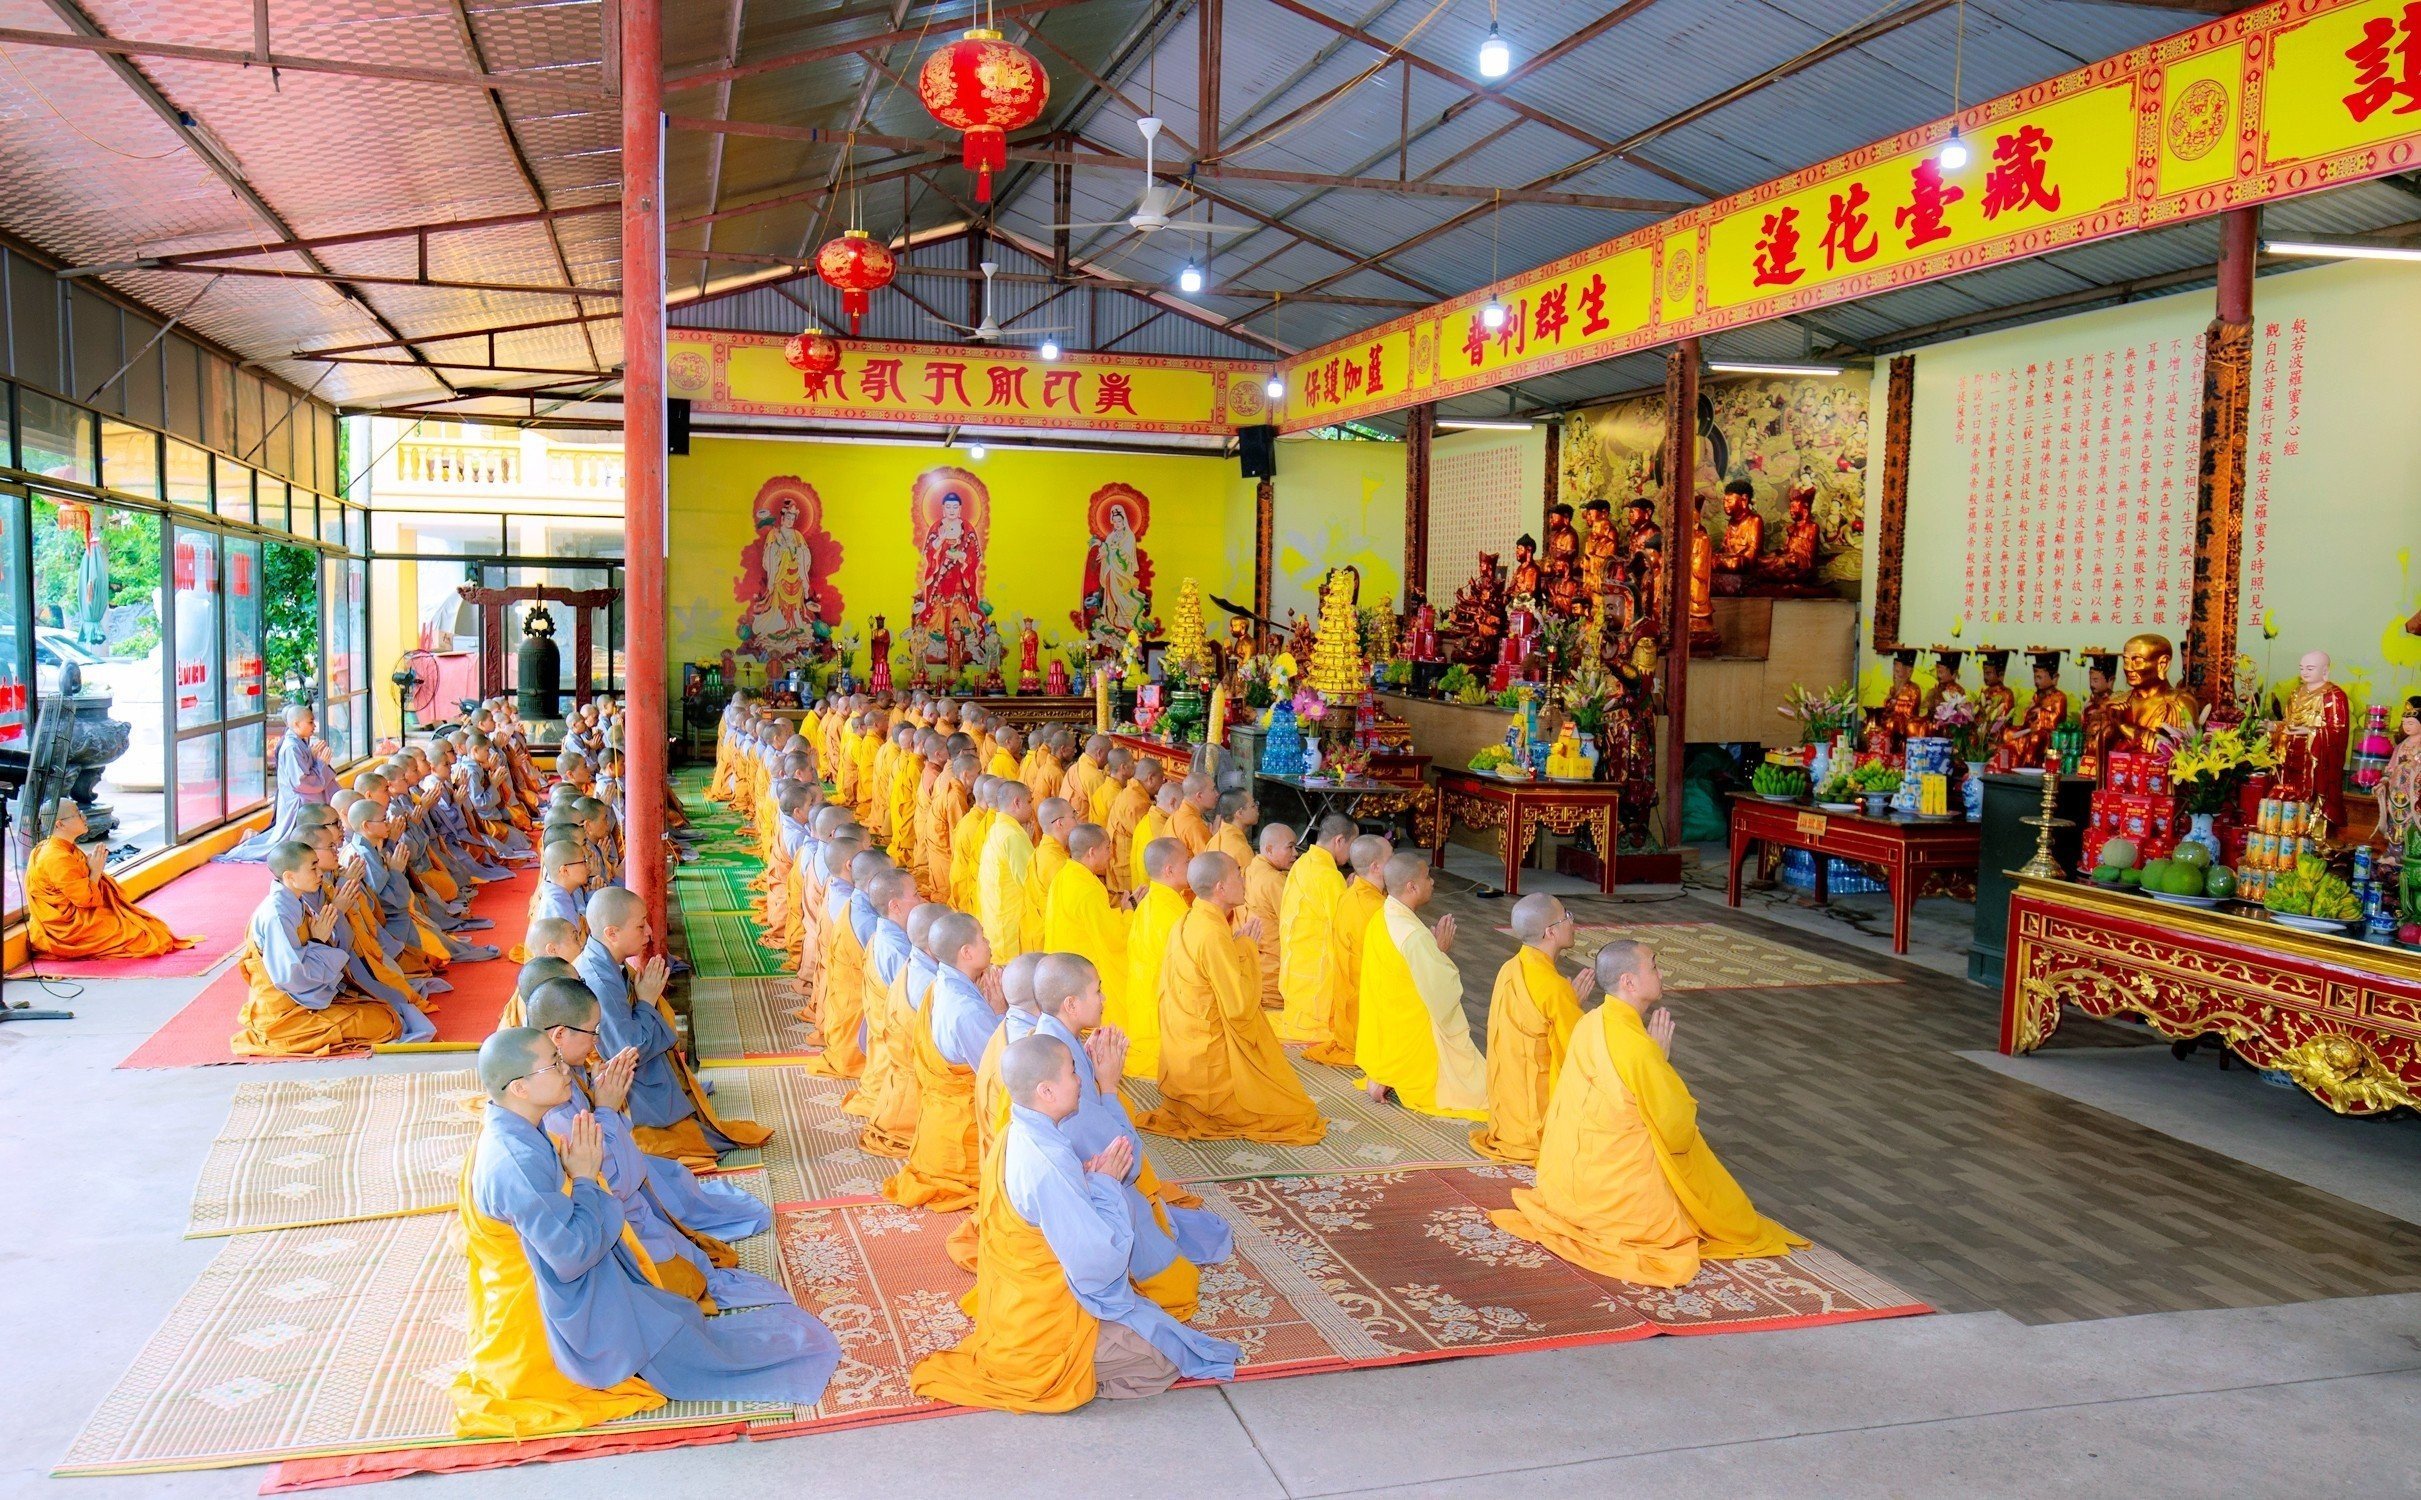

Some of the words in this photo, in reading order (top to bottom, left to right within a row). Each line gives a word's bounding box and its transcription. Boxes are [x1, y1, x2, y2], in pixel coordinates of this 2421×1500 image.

[1752, 124, 2061, 288] 蓮花臺藏
[1461, 273, 1610, 367] 普利群生
[2283, 318, 2307, 456] 般若波羅蜜多心經
[2248, 322, 2281, 626] 觀自在菩薩行深般若波羅蜜多時照見五
